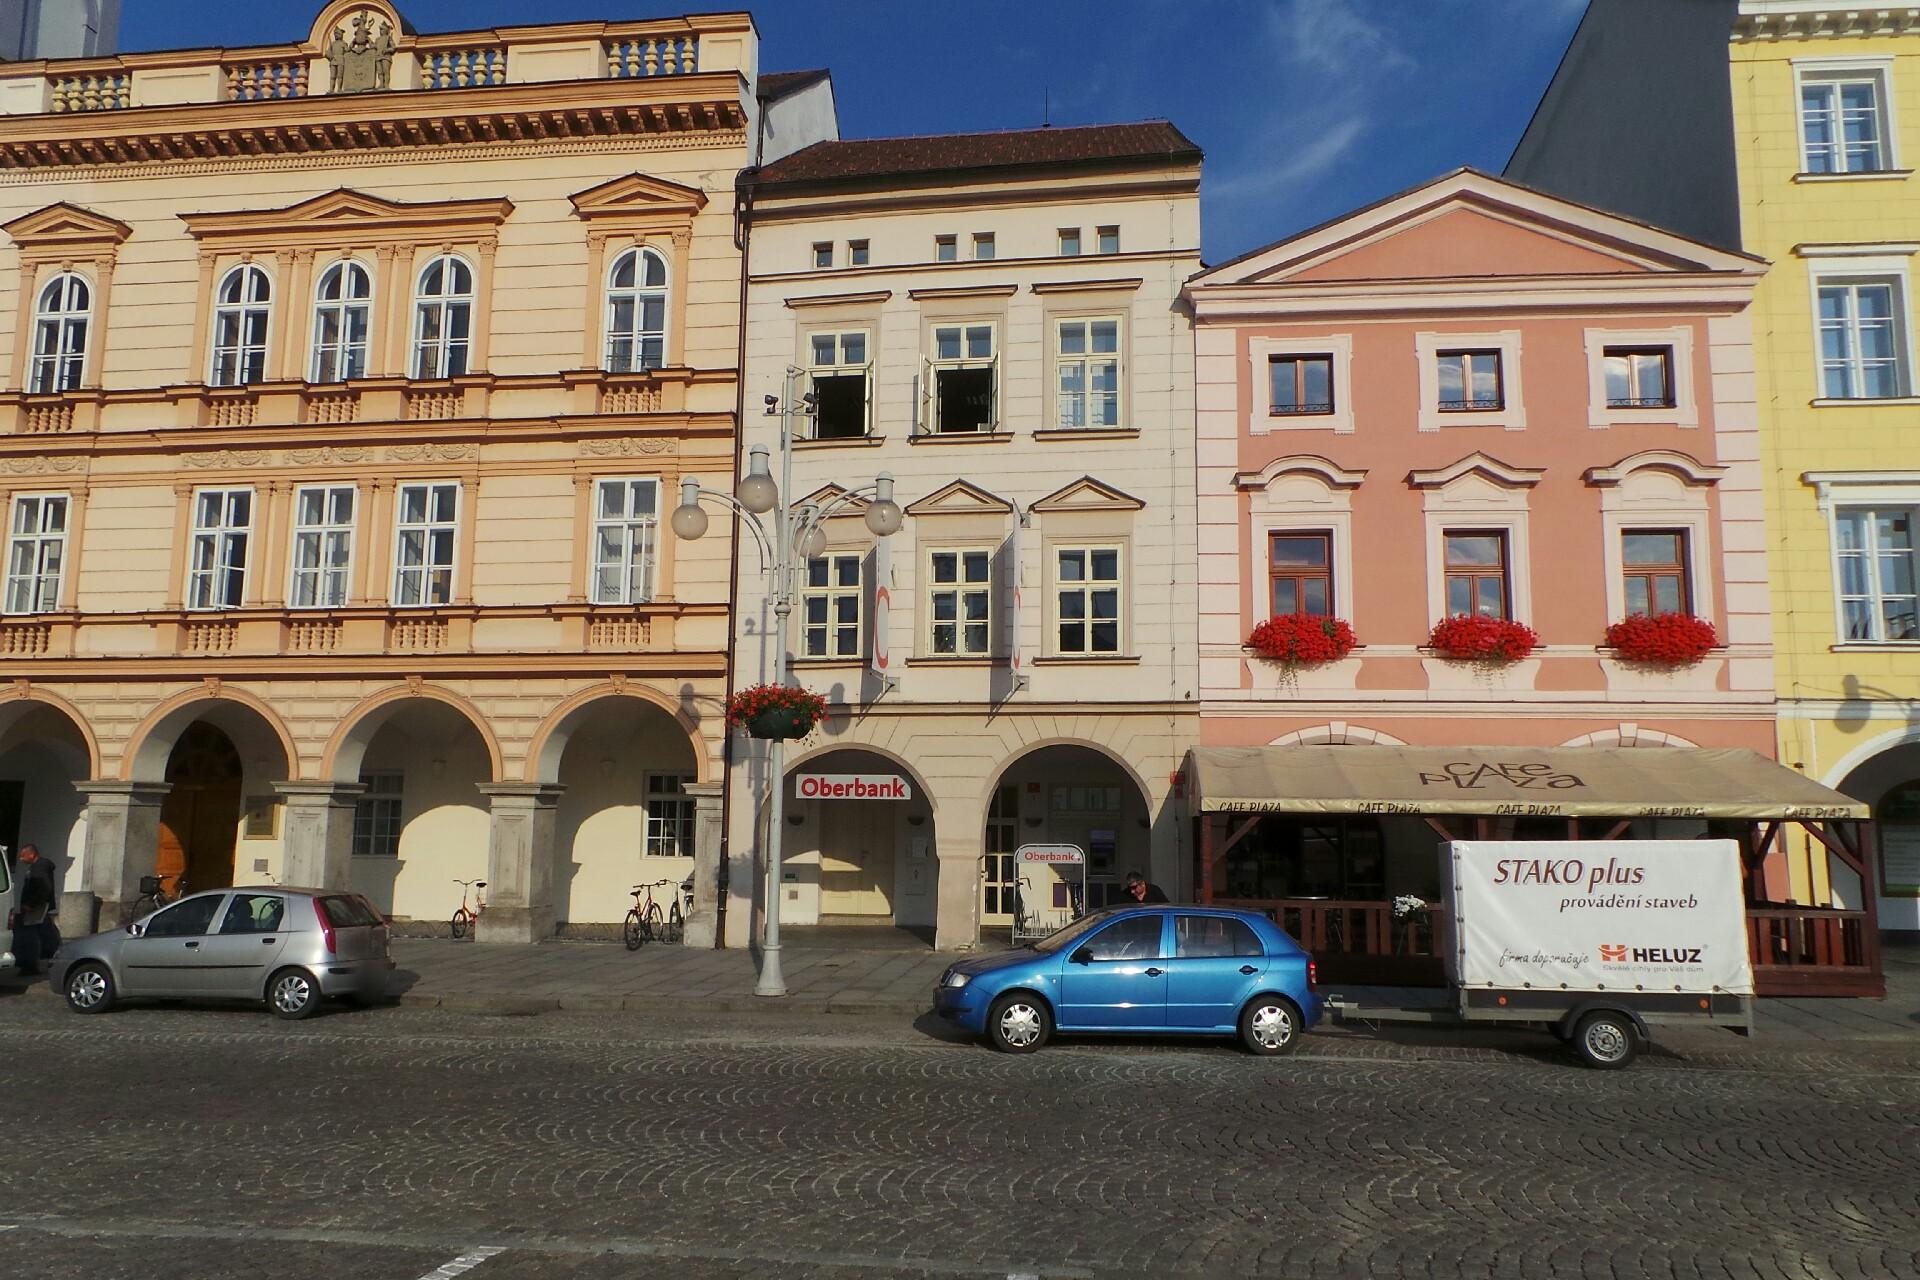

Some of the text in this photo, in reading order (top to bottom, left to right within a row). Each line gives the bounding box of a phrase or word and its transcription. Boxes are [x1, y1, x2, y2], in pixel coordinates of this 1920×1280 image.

[801, 777, 906, 797] Oberbank
[1024, 851, 1074, 861] Oberbank
[1494, 857, 1645, 894] STAKO plus
[1559, 894, 1698, 912] provádění staveb
[1632, 948, 1703, 963] HELUZ
